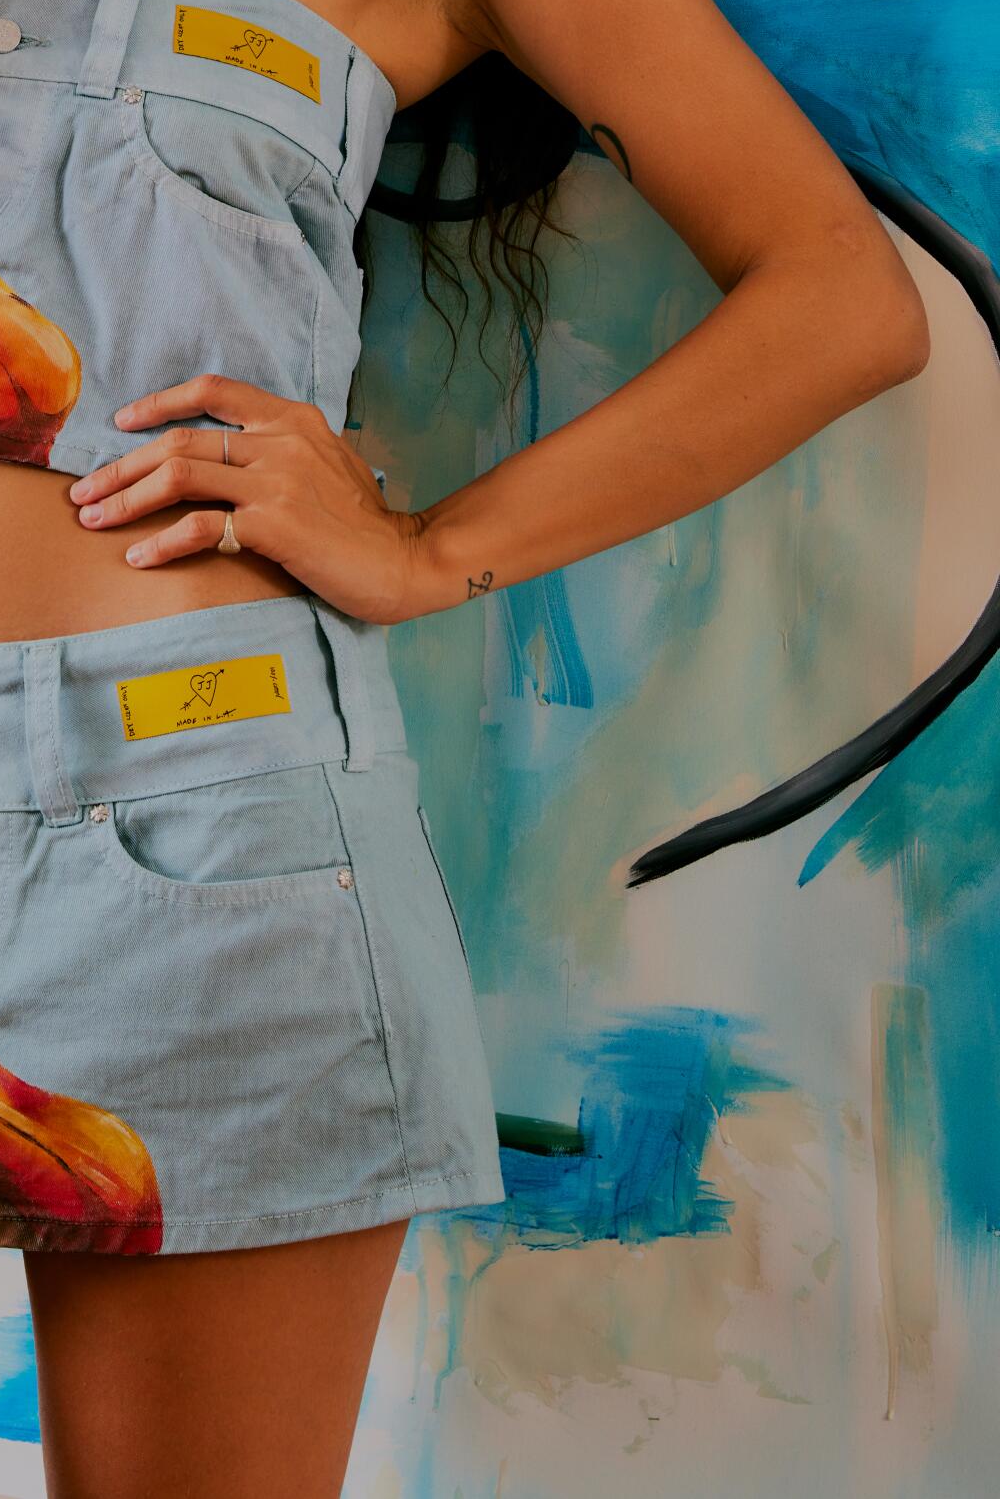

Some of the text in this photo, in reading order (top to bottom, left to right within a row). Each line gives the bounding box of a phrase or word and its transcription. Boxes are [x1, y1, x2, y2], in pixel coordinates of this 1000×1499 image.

[225, 55, 244, 64] MADE
[120, 685, 128, 702] ONLY
[176, 717, 197, 727] MADE
